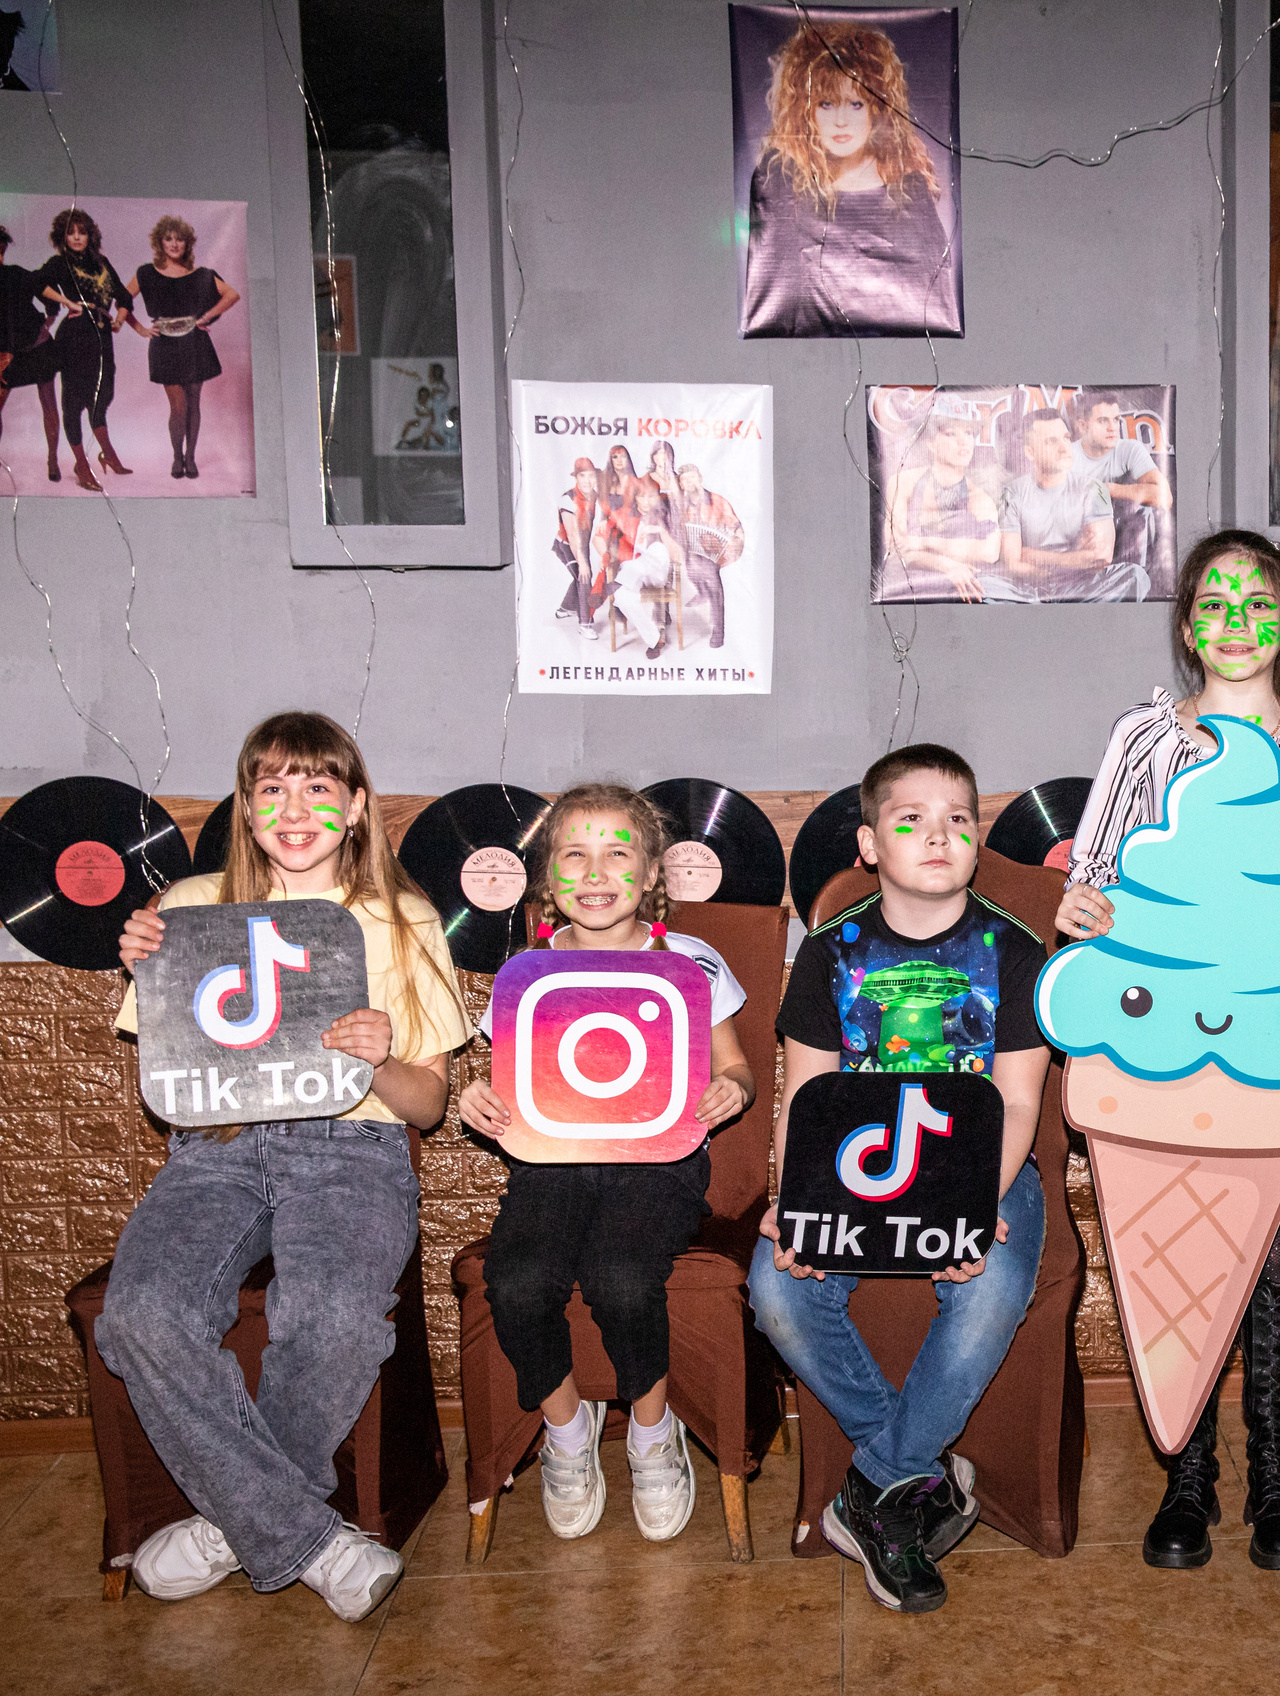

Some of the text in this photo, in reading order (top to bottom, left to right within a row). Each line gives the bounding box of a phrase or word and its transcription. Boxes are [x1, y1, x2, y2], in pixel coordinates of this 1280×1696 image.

[534, 415, 762, 440] БОЖЬЯ КОРОВКА
[867, 384, 1174, 455] Cr Mn
[549, 666, 746, 682] ЛЕГЕНДАРНЫЕ ХИТЫ
[471, 851, 518, 868] МЕЛОДИЯ
[668, 846, 712, 862] МЕЛОДИЯ
[150, 1057, 364, 1115] Tik Tok
[783, 1211, 985, 1260] Tik Tok
